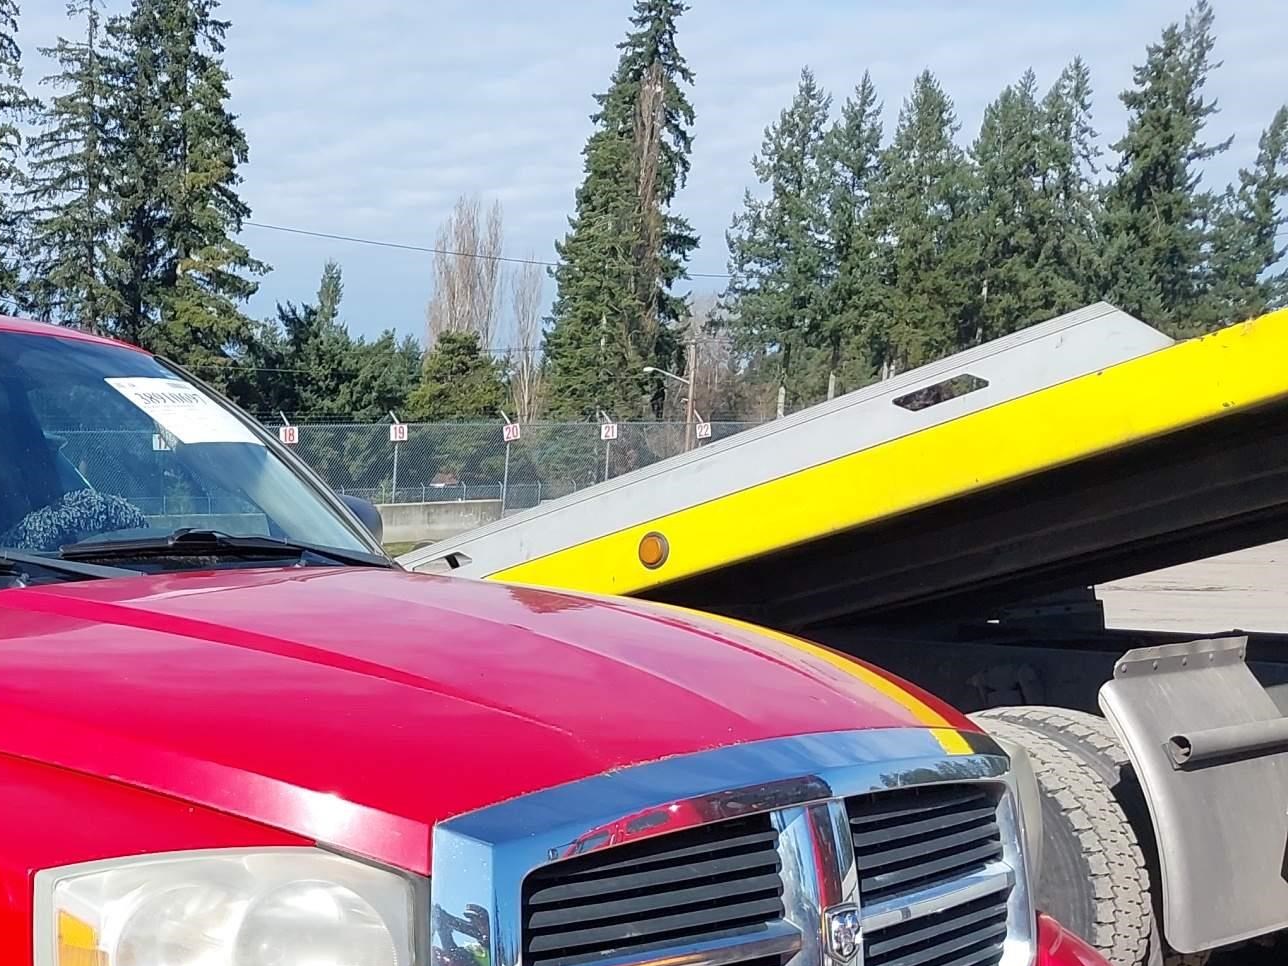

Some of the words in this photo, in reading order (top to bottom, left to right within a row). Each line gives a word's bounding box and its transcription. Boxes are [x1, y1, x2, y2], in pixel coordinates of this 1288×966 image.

[282, 427, 295, 442] 18
[393, 425, 405, 440] 19
[505, 425, 518, 440] 20
[604, 425, 615, 438] 21
[697, 424, 710, 437] 22
